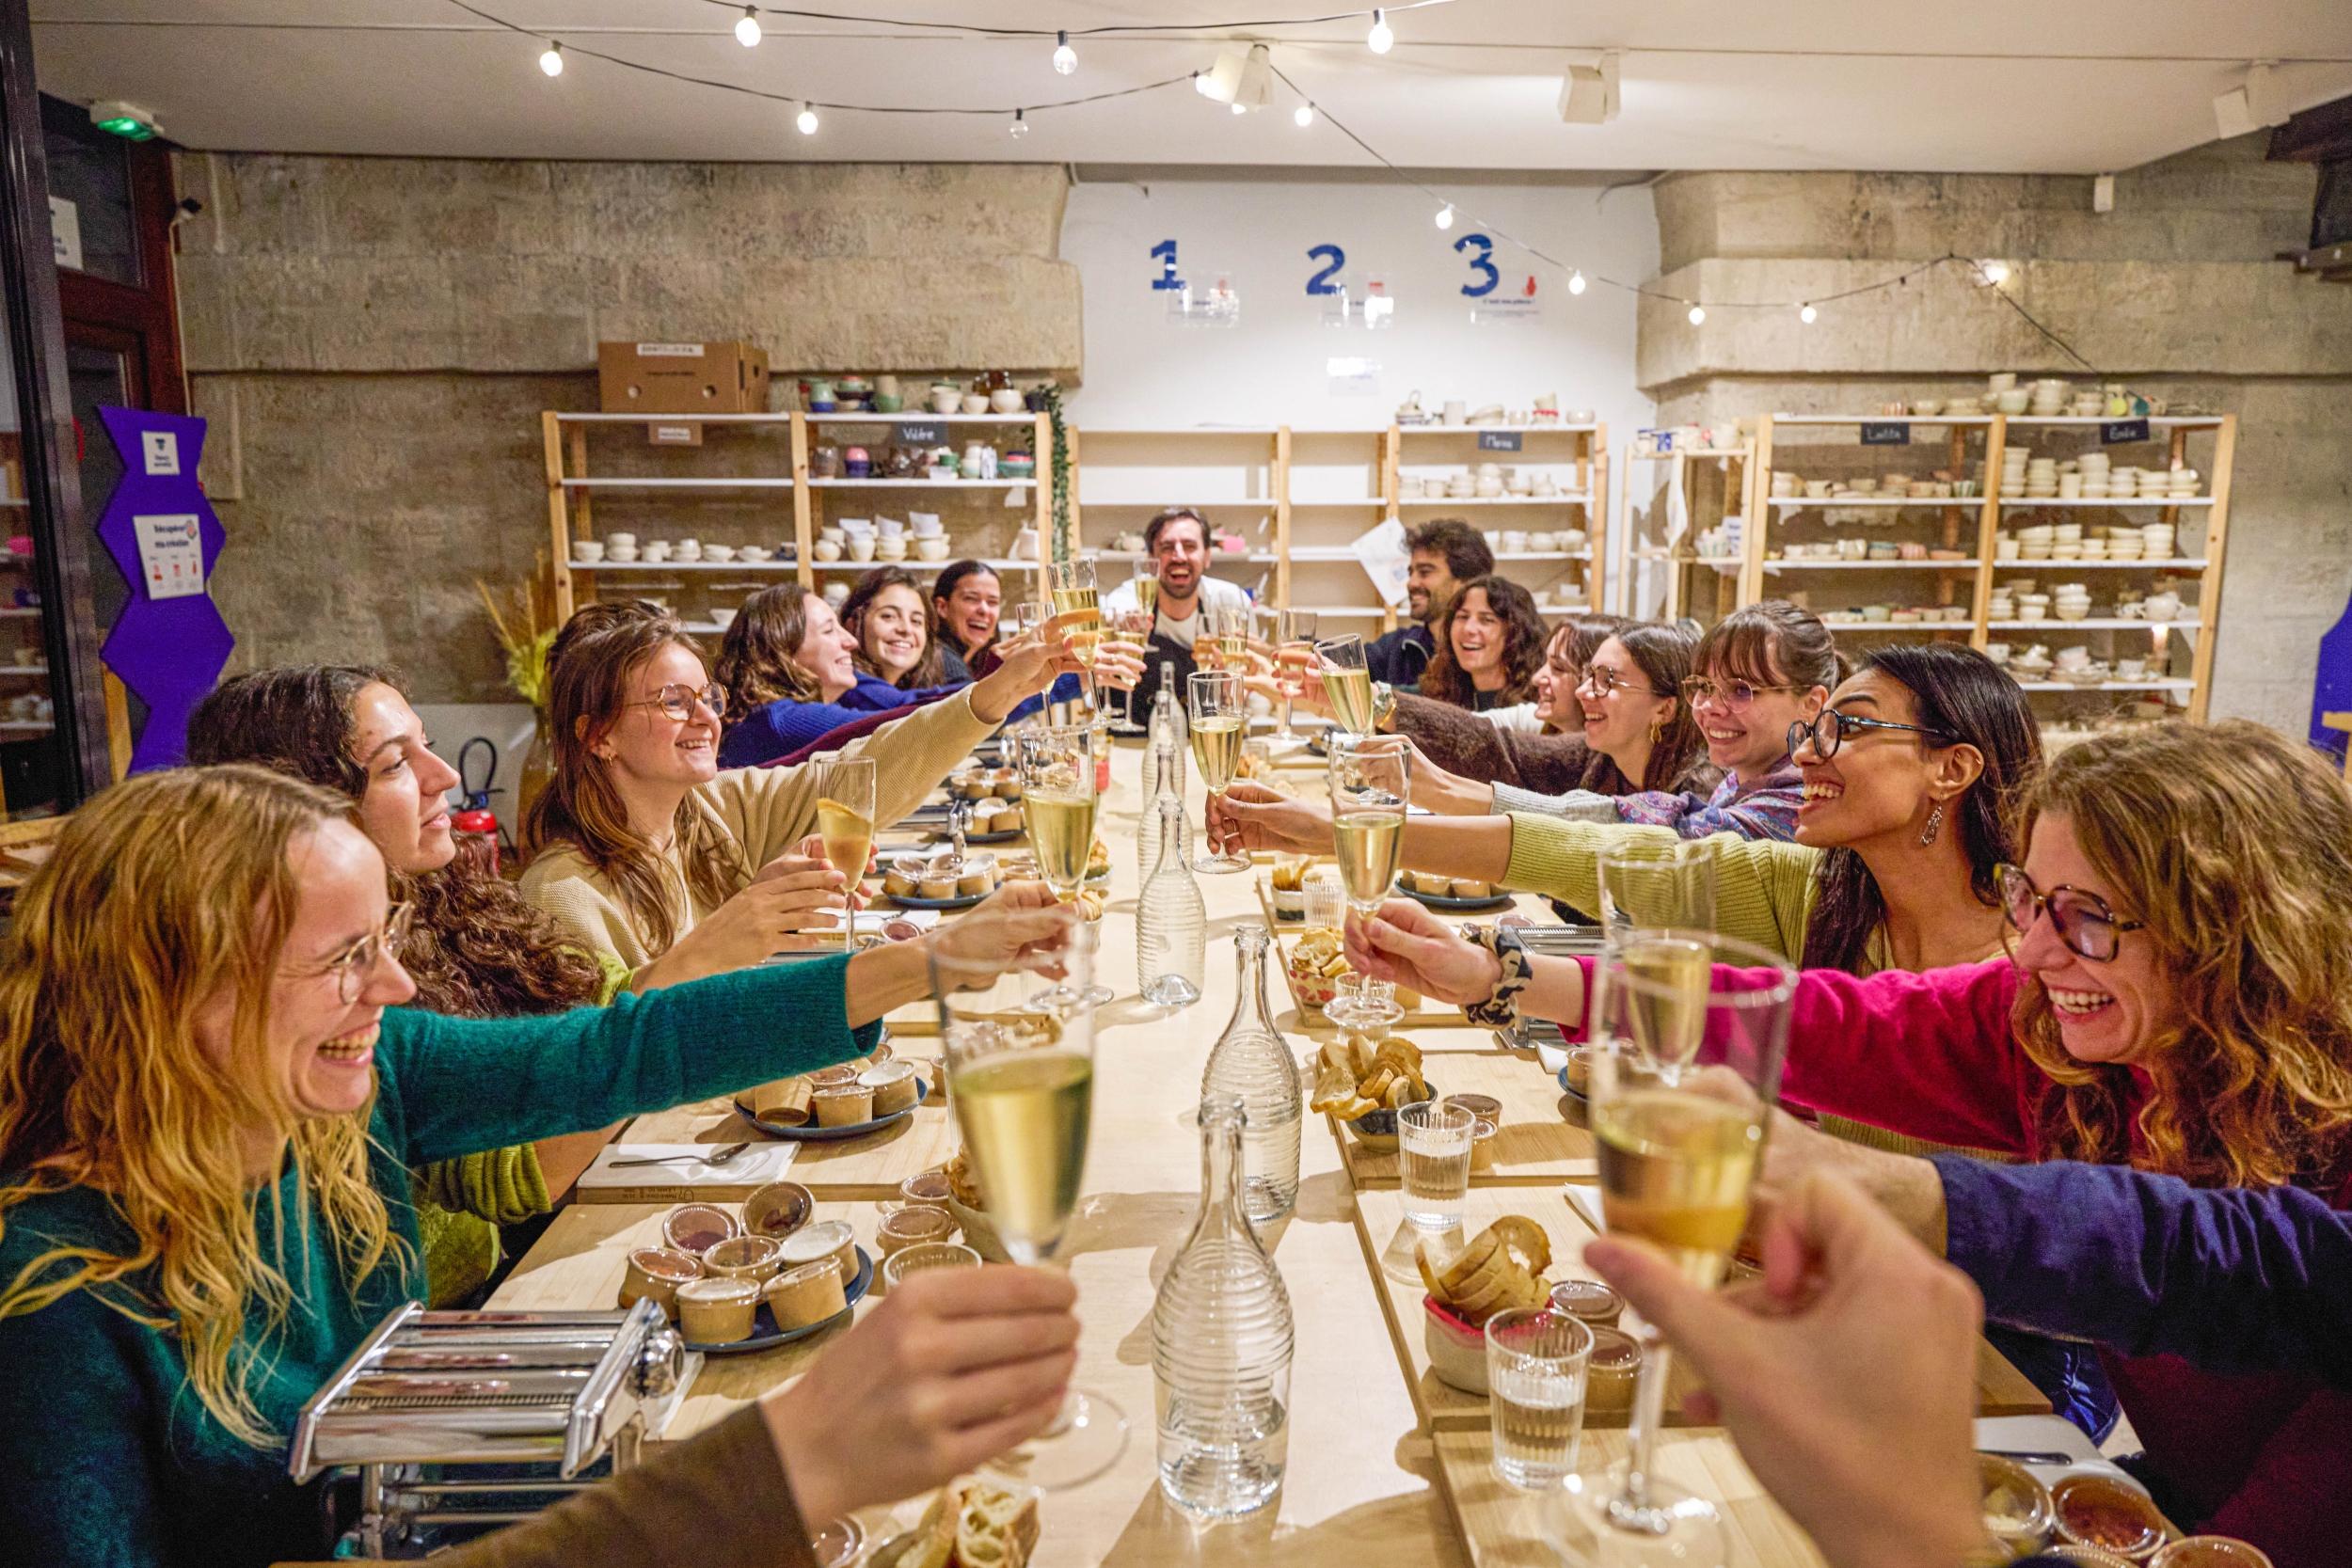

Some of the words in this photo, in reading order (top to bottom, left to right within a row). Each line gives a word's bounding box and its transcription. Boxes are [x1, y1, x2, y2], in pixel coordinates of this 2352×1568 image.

[1151, 240, 1185, 290] 1
[1306, 244, 1346, 295] 2
[1454, 233, 1499, 297] 3
